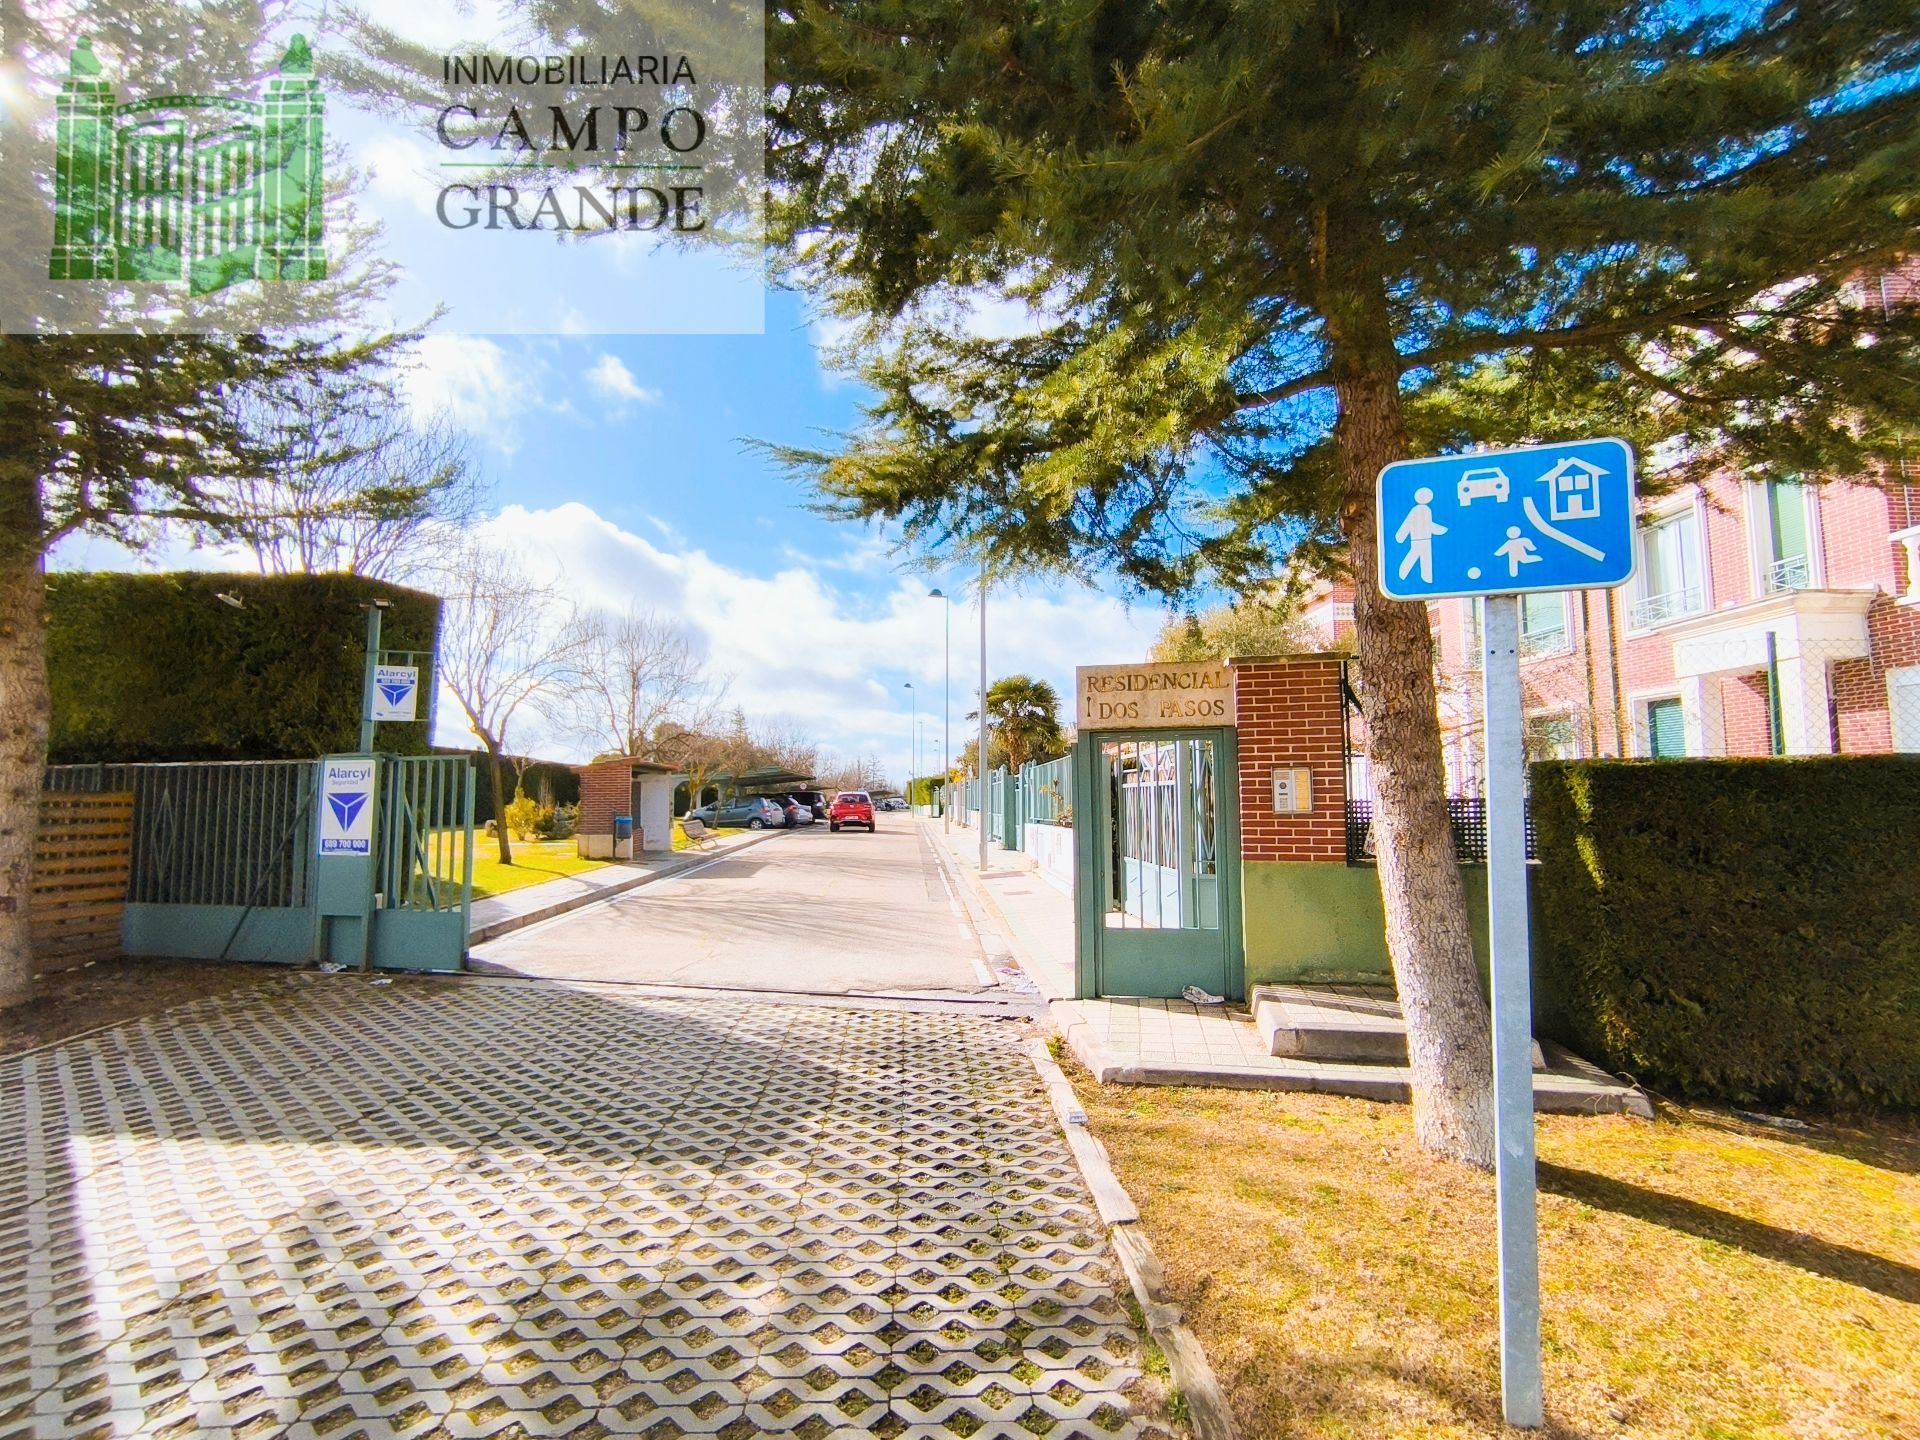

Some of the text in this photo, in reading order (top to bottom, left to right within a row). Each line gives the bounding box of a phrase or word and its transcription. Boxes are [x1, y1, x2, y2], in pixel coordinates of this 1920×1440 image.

[378, 669, 416, 679] Alarcyl
[1087, 672, 1229, 693] RESIDENCIAL
[1099, 702, 1138, 719] DOS
[1160, 700, 1224, 718] PASOS
[328, 767, 371, 781] Alarcyl
[338, 839, 352, 849] 700
